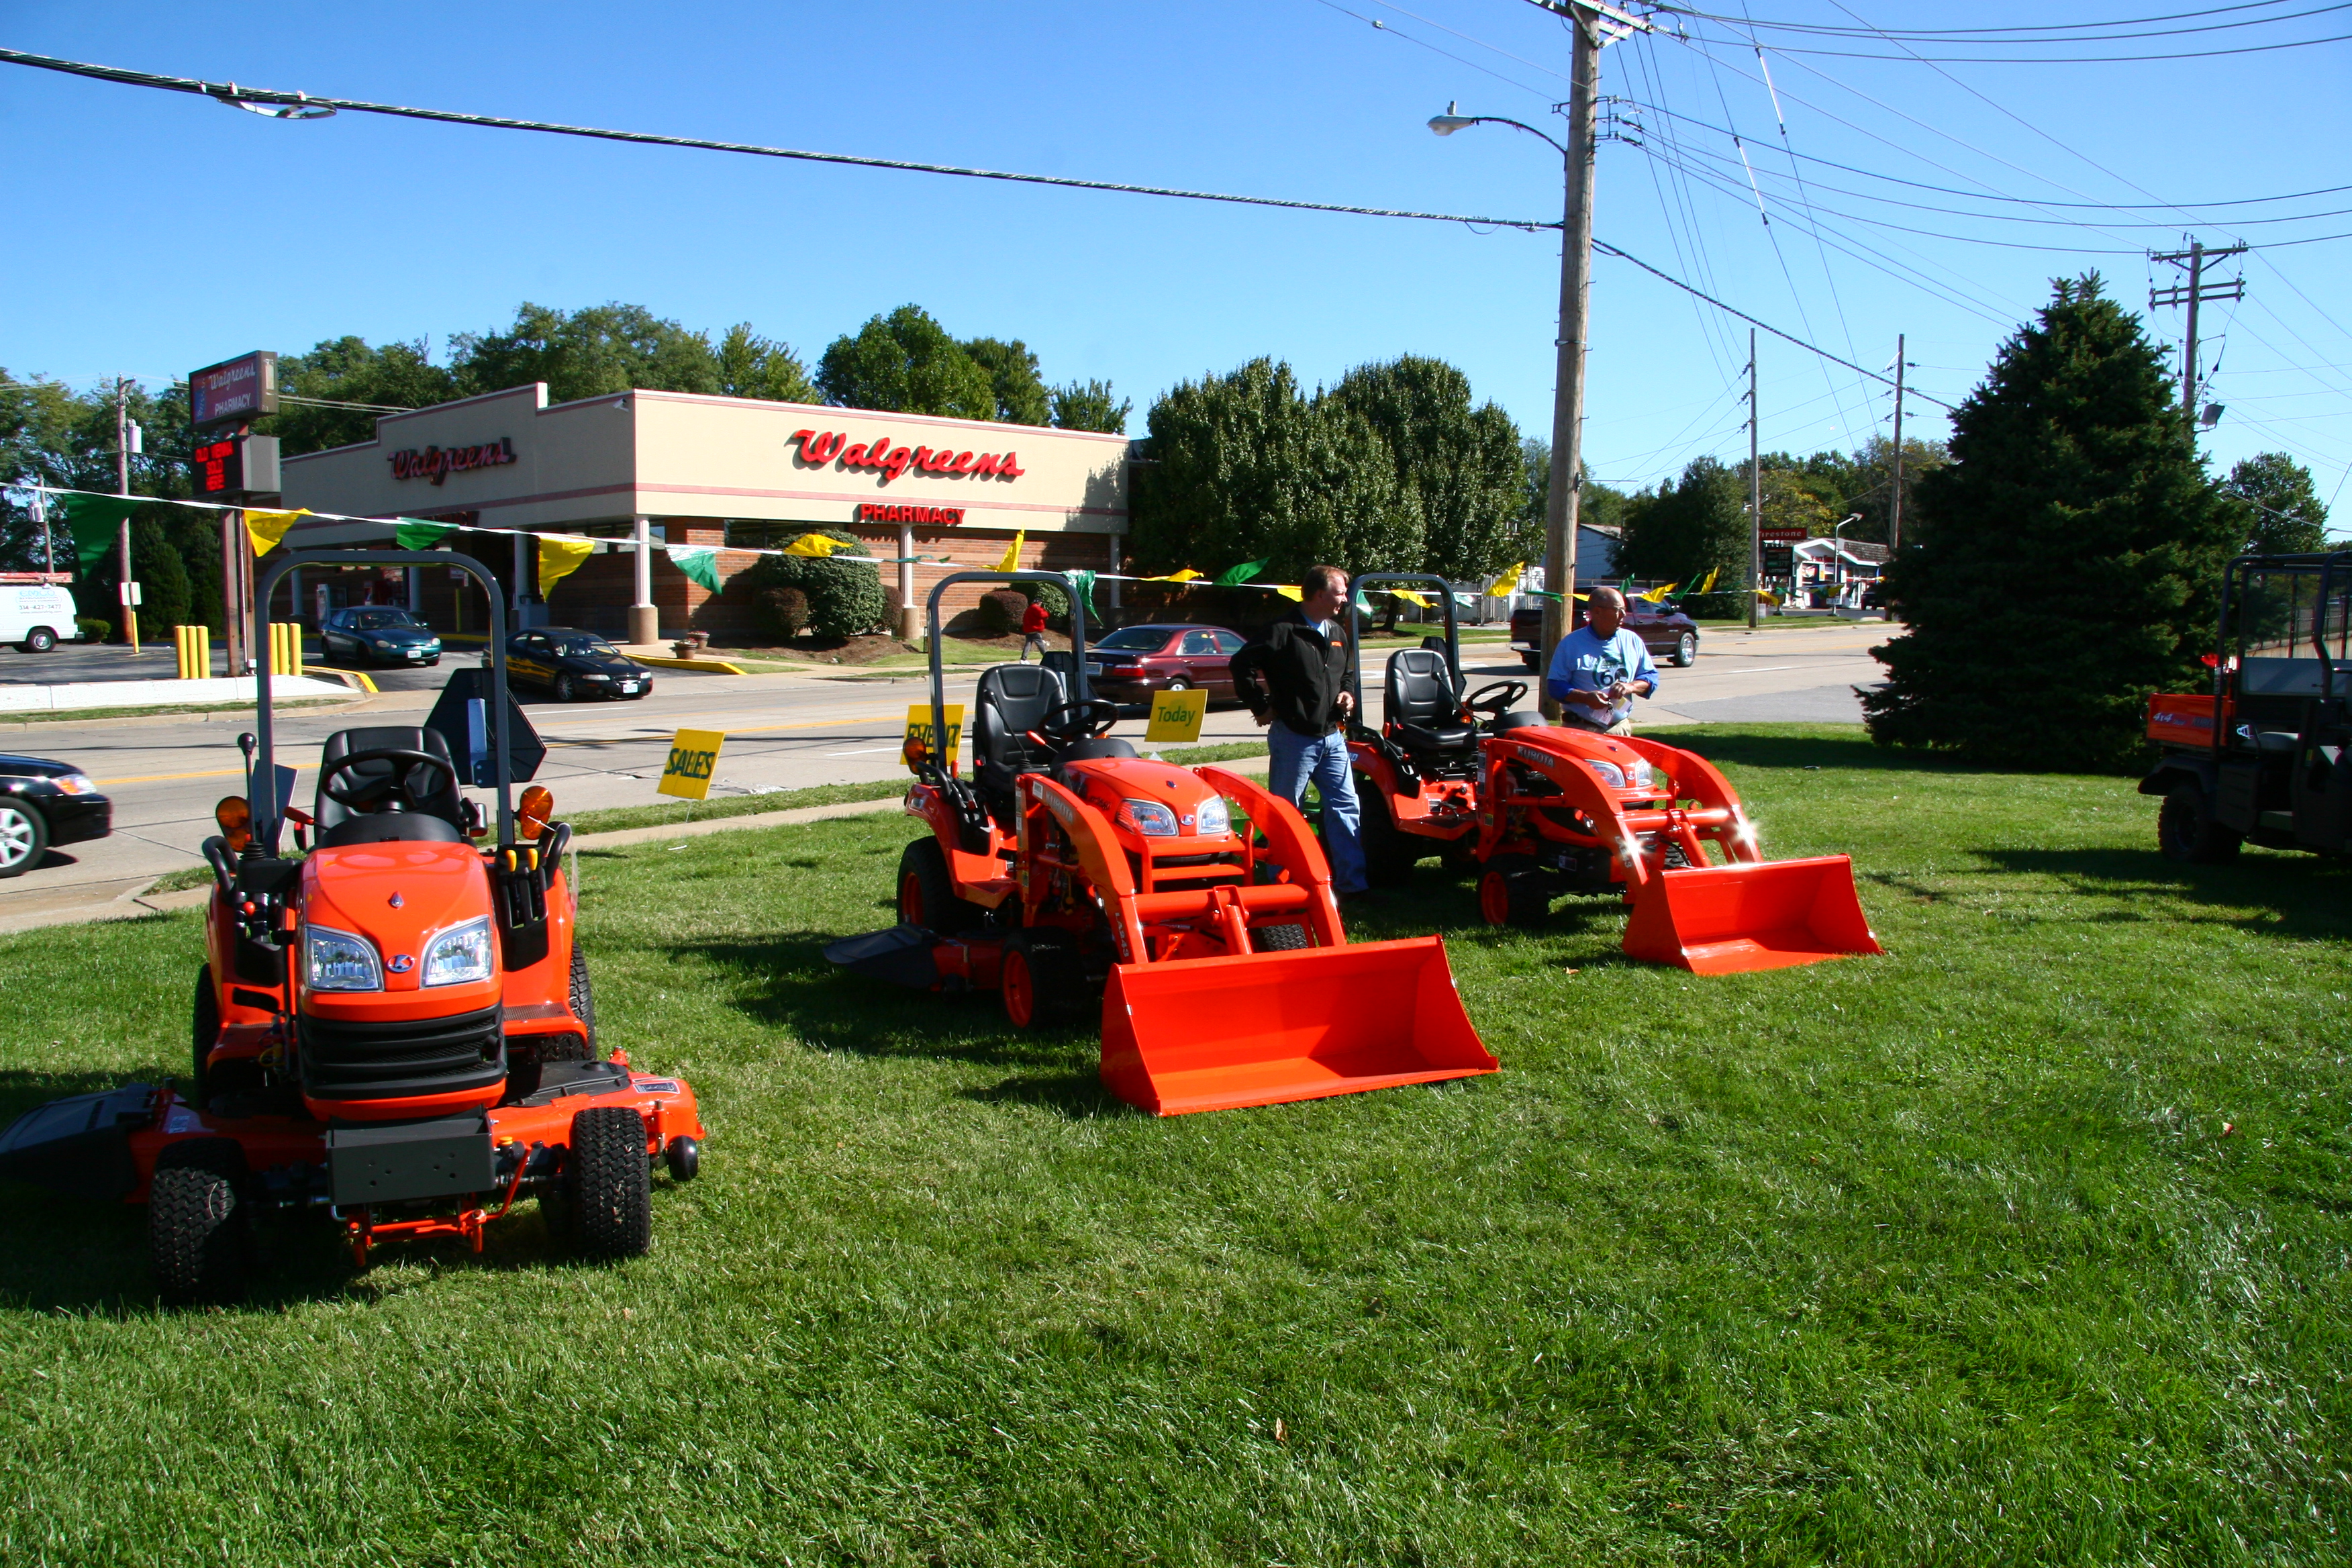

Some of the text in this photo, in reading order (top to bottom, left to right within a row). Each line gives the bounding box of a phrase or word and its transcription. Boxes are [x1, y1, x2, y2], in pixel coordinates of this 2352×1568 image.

[209, 363, 256, 391] Walgreens
[215, 393, 251, 416] PHARMACY
[387, 438, 517, 486] Walgreens
[793, 428, 1026, 481] Walgreens
[859, 503, 967, 525] PHARMACY
[1158, 706, 1196, 727] Today
[2153, 712, 2173, 723] 4x4
[906, 724, 962, 748] EVET
[664, 748, 716, 779] SALES
[1518, 746, 1555, 768] KUBOTA
